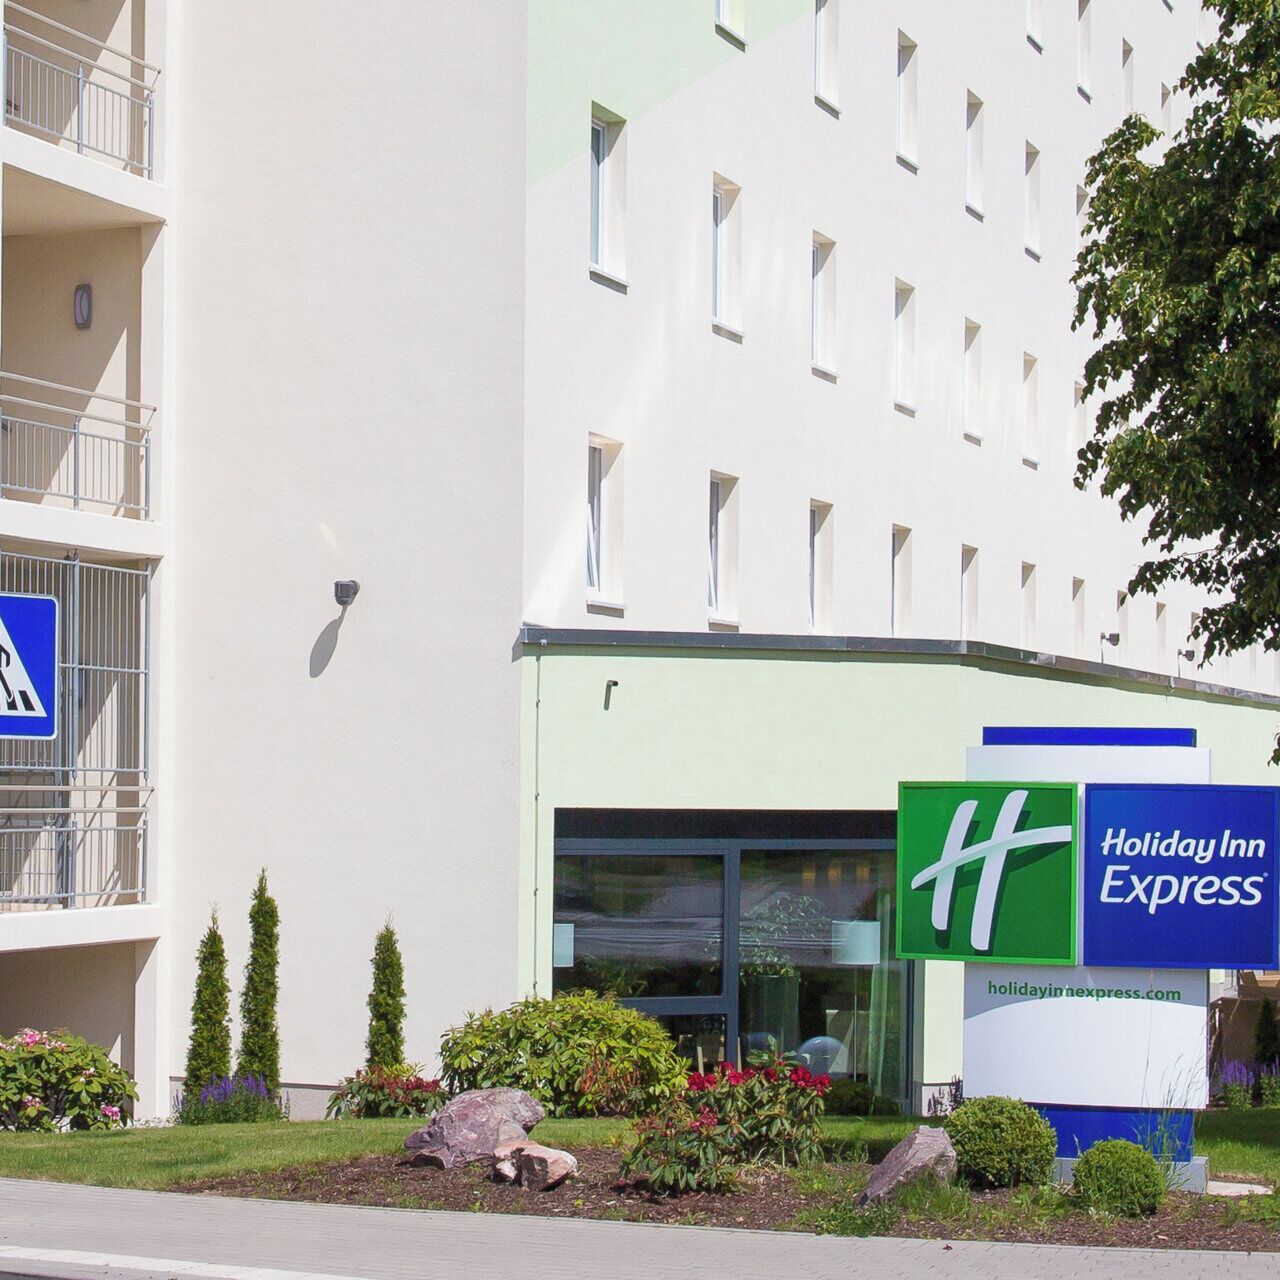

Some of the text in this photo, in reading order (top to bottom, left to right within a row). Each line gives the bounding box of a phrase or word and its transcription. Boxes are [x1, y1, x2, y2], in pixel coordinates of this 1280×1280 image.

[1101, 828, 1266, 864] Holiday Inn
[1100, 865, 1264, 915] Express
[988, 981, 1181, 1001] holidayinnexpress.com
